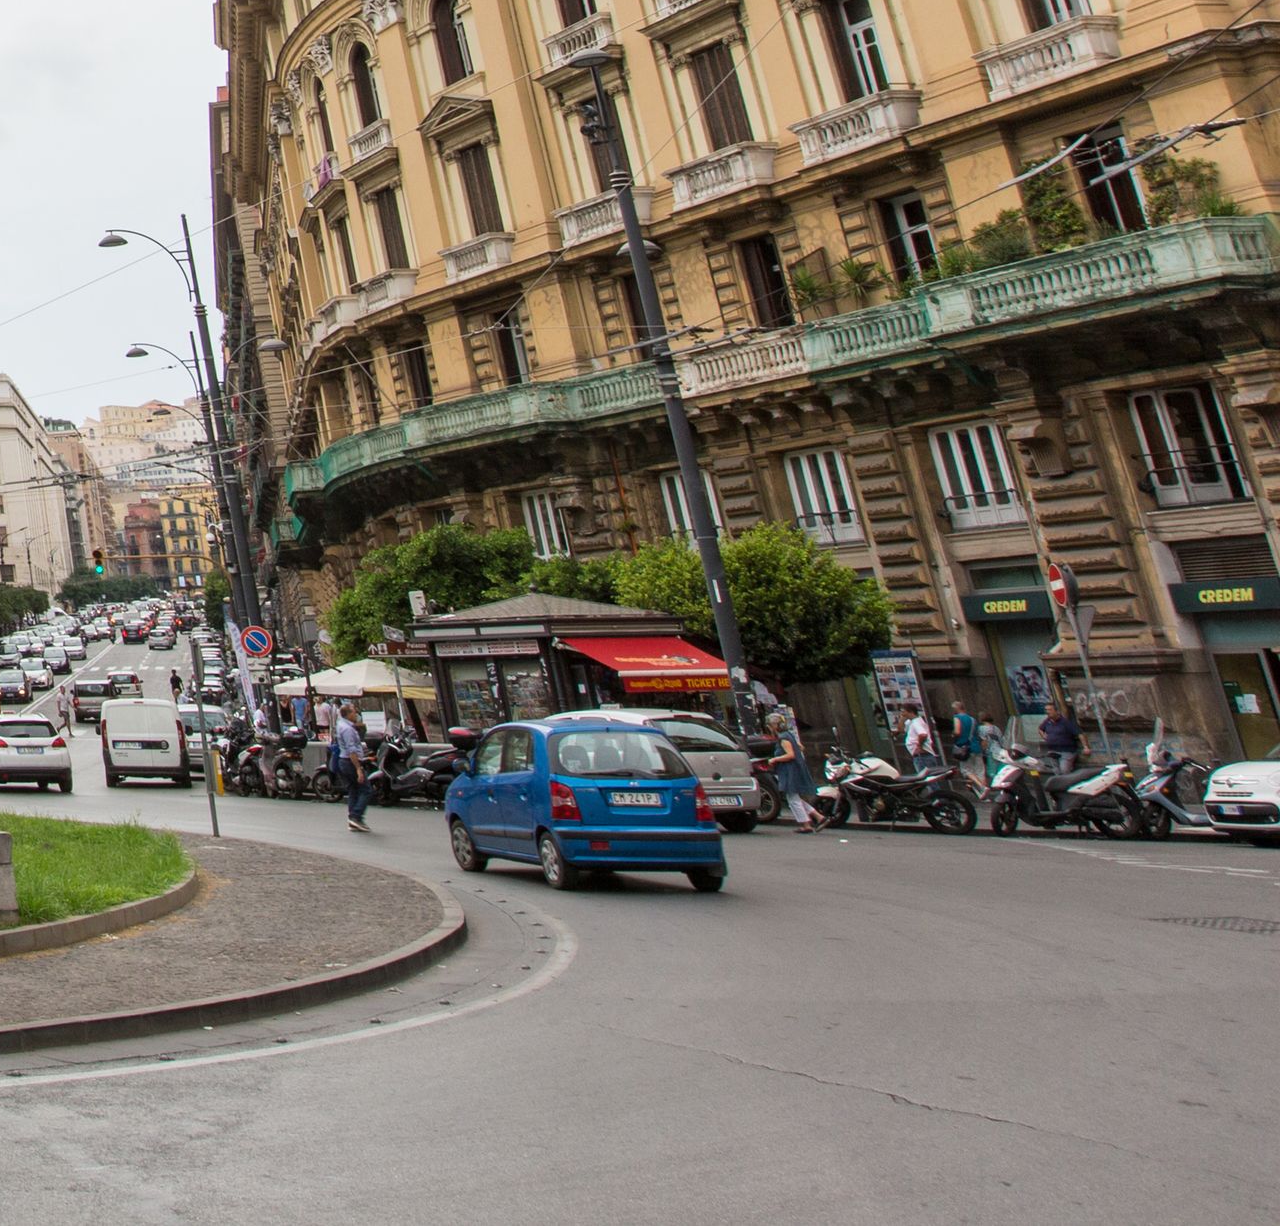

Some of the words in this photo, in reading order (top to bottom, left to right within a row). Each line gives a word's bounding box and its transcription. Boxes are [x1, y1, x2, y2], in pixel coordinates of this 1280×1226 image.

[1198, 587, 1255, 604] CREDEM
[983, 599, 1028, 616] CREDEM
[686, 678, 716, 688] TICKET
